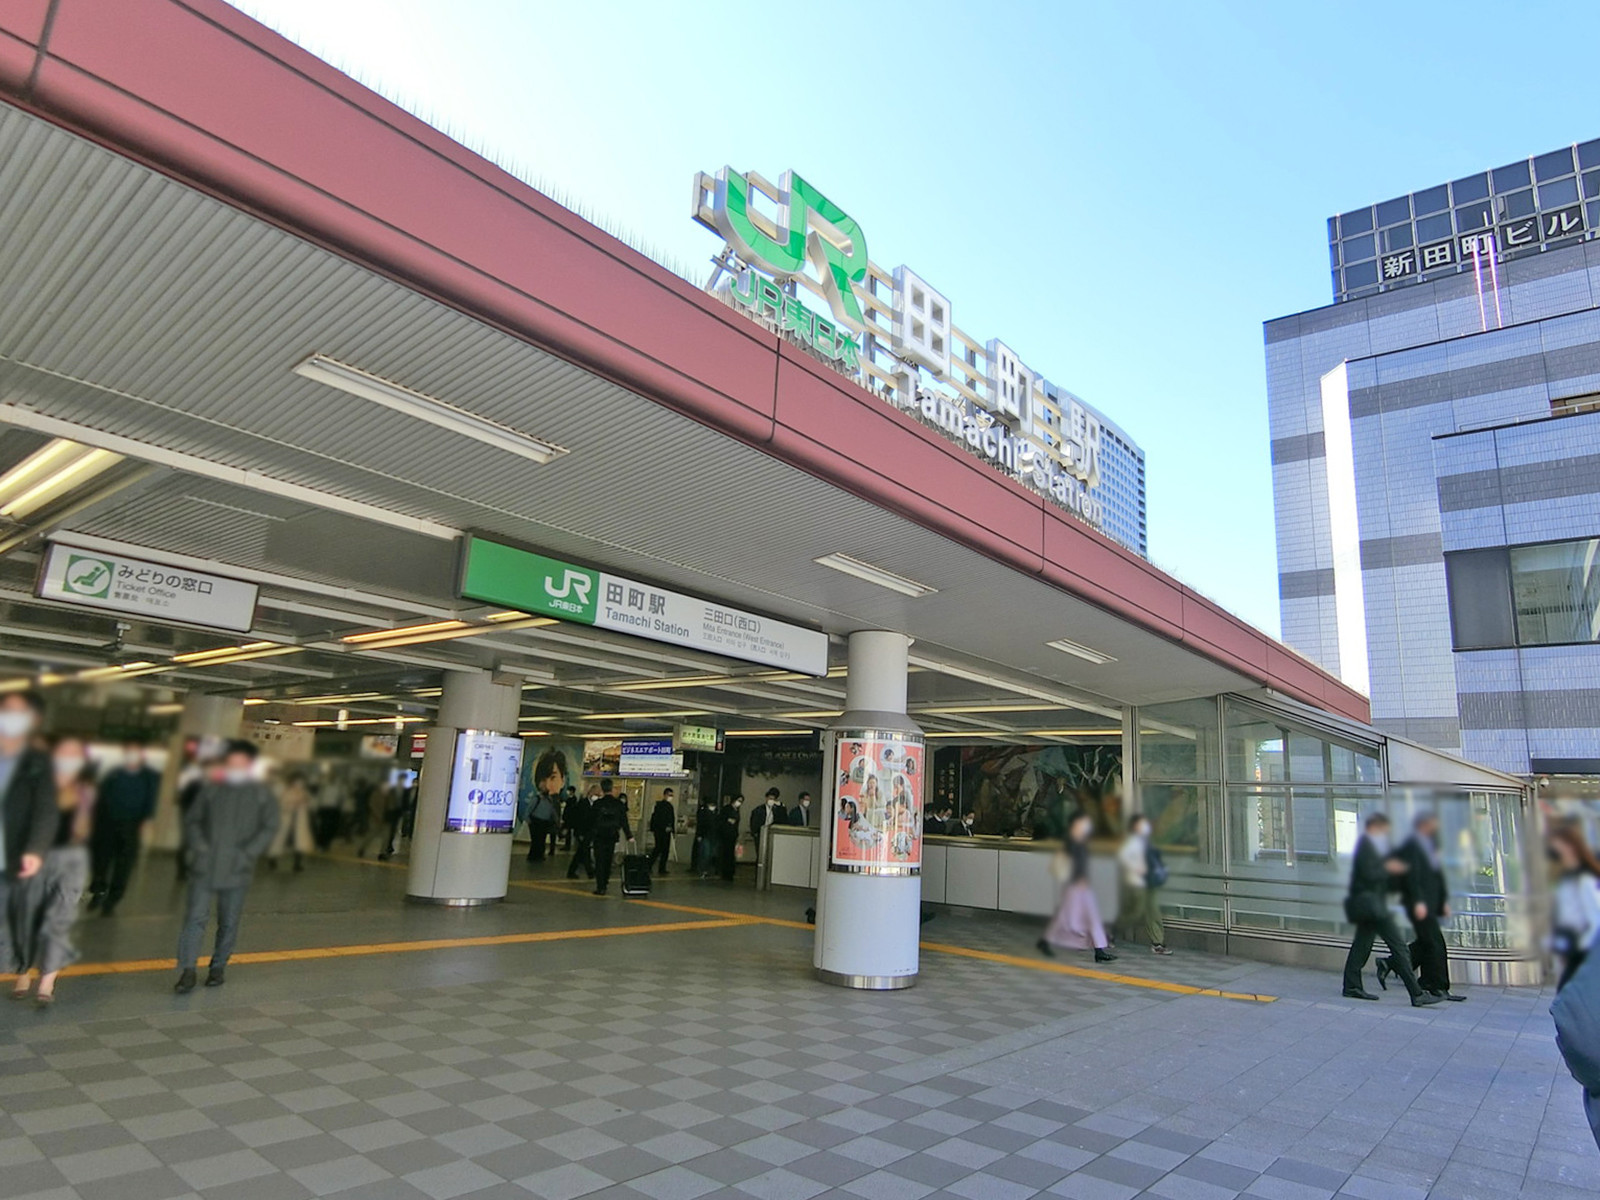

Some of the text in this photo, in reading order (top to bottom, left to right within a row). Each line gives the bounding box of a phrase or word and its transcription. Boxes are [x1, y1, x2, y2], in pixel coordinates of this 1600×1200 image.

[714, 165, 868, 333] JR
[1384, 213, 1579, 277] 新田町ビル
[729, 269, 861, 376] JR東日本
[894, 264, 1101, 487] 田町駅
[894, 364, 1102, 524] Tamachi Station
[116, 580, 146, 594] Ticket
[147, 586, 177, 599] Office
[118, 564, 213, 595] みどりの窓口
[544, 569, 592, 605] JR
[549, 599, 583, 614] JR東日本
[606, 582, 665, 616] 田町駅
[605, 606, 690, 638] Tamachi Station
[703, 622, 716, 632] Mita
[716, 626, 742, 639] Entrance
[704, 607, 761, 633] 三田口(西口)
